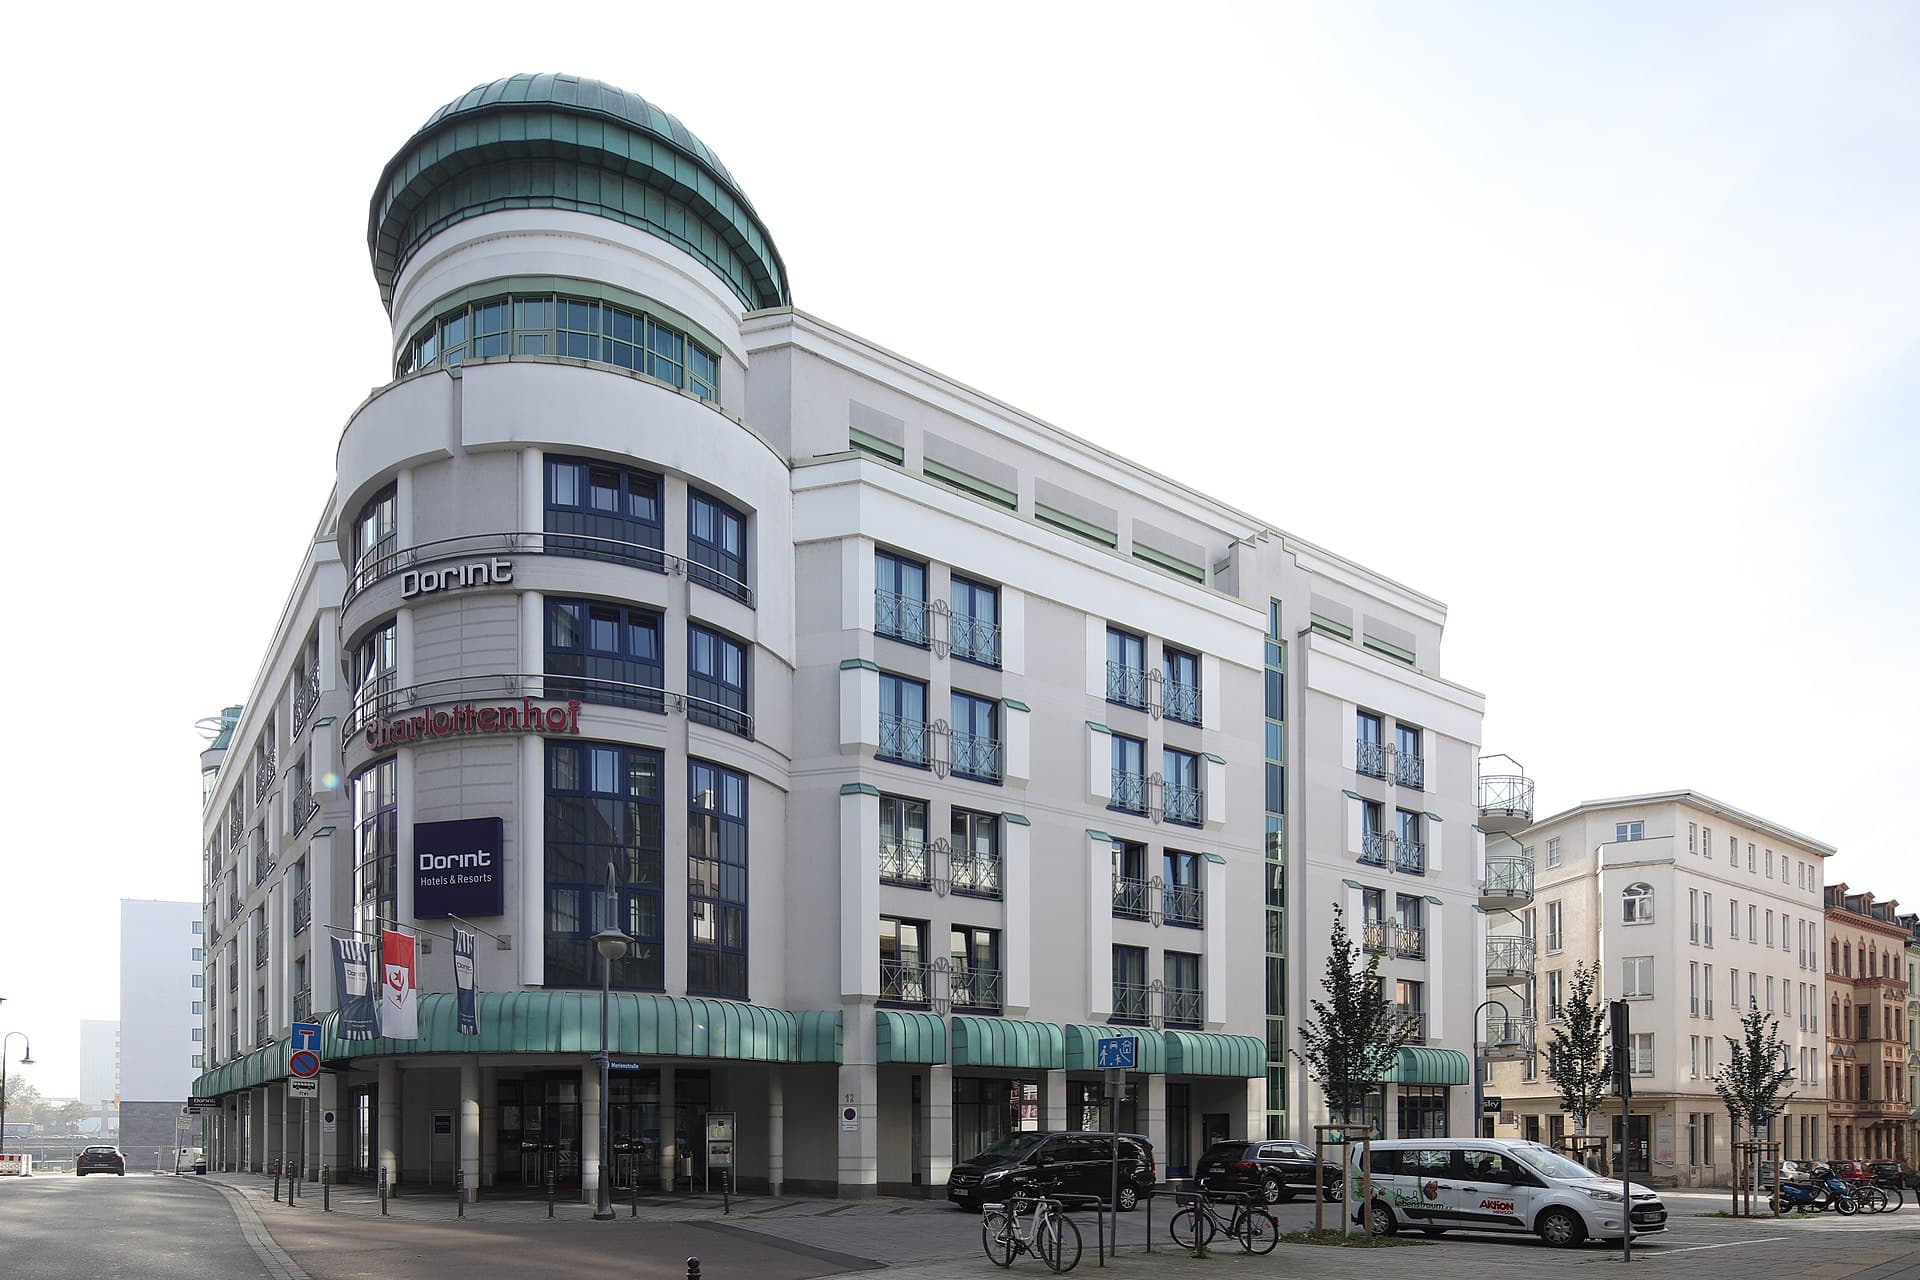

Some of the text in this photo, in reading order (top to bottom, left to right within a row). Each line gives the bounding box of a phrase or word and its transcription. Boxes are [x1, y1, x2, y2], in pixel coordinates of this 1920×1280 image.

[400, 557, 512, 599] Dorint
[364, 697, 582, 750] Charlottenhof
[419, 849, 492, 871] Dorint
[420, 873, 492, 887] Hotels & Resorts
[844, 1093, 855, 1103] 12
